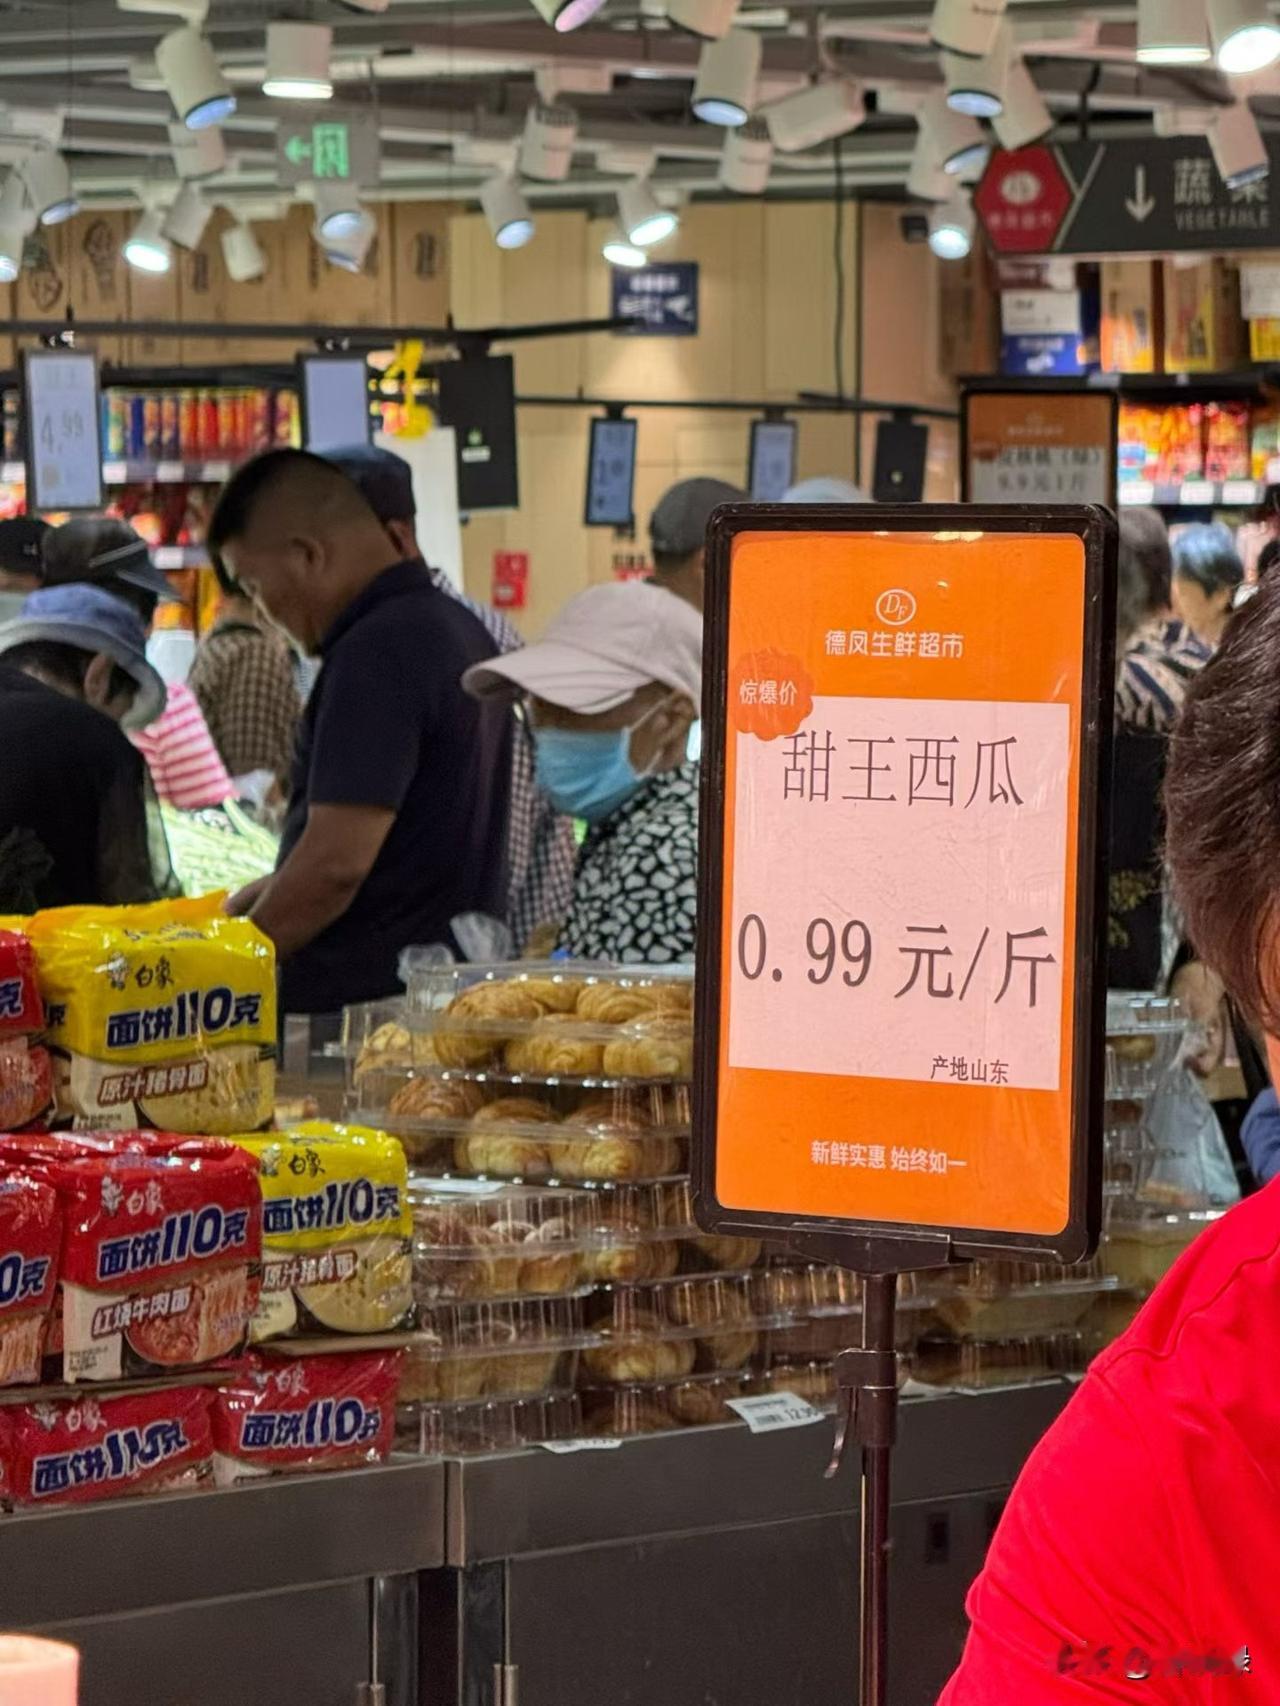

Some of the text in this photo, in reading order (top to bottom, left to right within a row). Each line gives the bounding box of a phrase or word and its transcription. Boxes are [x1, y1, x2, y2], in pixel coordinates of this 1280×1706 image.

[825, 630, 964, 659] 德凤生鲜超市
[738, 679, 798, 706] 惊爆价
[781, 730, 1024, 809] 甜王西瓜
[107, 986, 262, 1048] 面饼110克
[930, 1055, 1010, 1085] 产地山东
[810, 1140, 968, 1174] 新鲜实惠 始终如一
[262, 1178, 400, 1233] 面饼110克
[98, 1204, 249, 1280] 面饼110克
[92, 1285, 192, 1339] 红烧牛肉面
[241, 1398, 381, 1448] 面饼110克
